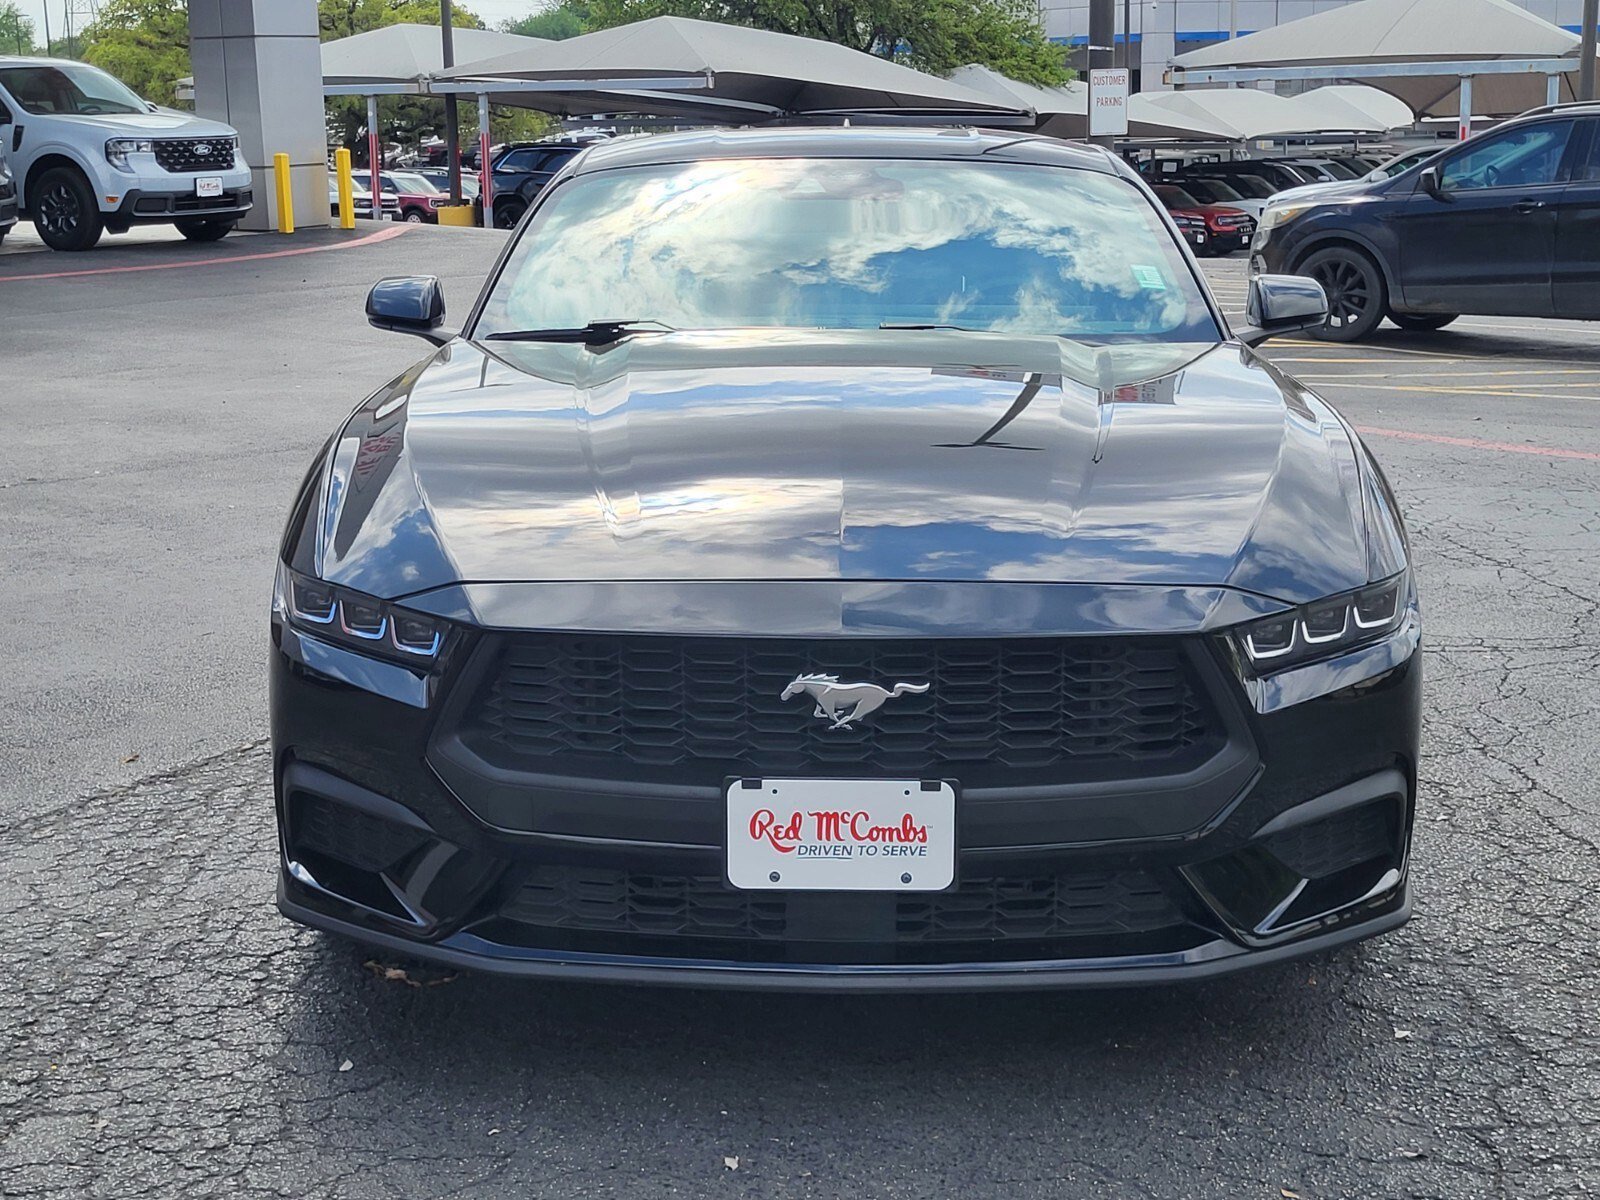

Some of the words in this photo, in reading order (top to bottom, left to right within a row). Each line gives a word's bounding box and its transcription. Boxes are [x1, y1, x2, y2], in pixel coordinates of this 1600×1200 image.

[1093, 75, 1126, 86] CUSTOMER
[1096, 96, 1123, 107] PARKING
[750, 809, 802, 853] Red
[807, 811, 927, 843] McCombs
[797, 845, 853, 856] DRIVEN
[858, 845, 878, 857] TO
[881, 845, 927, 857] SERVE
